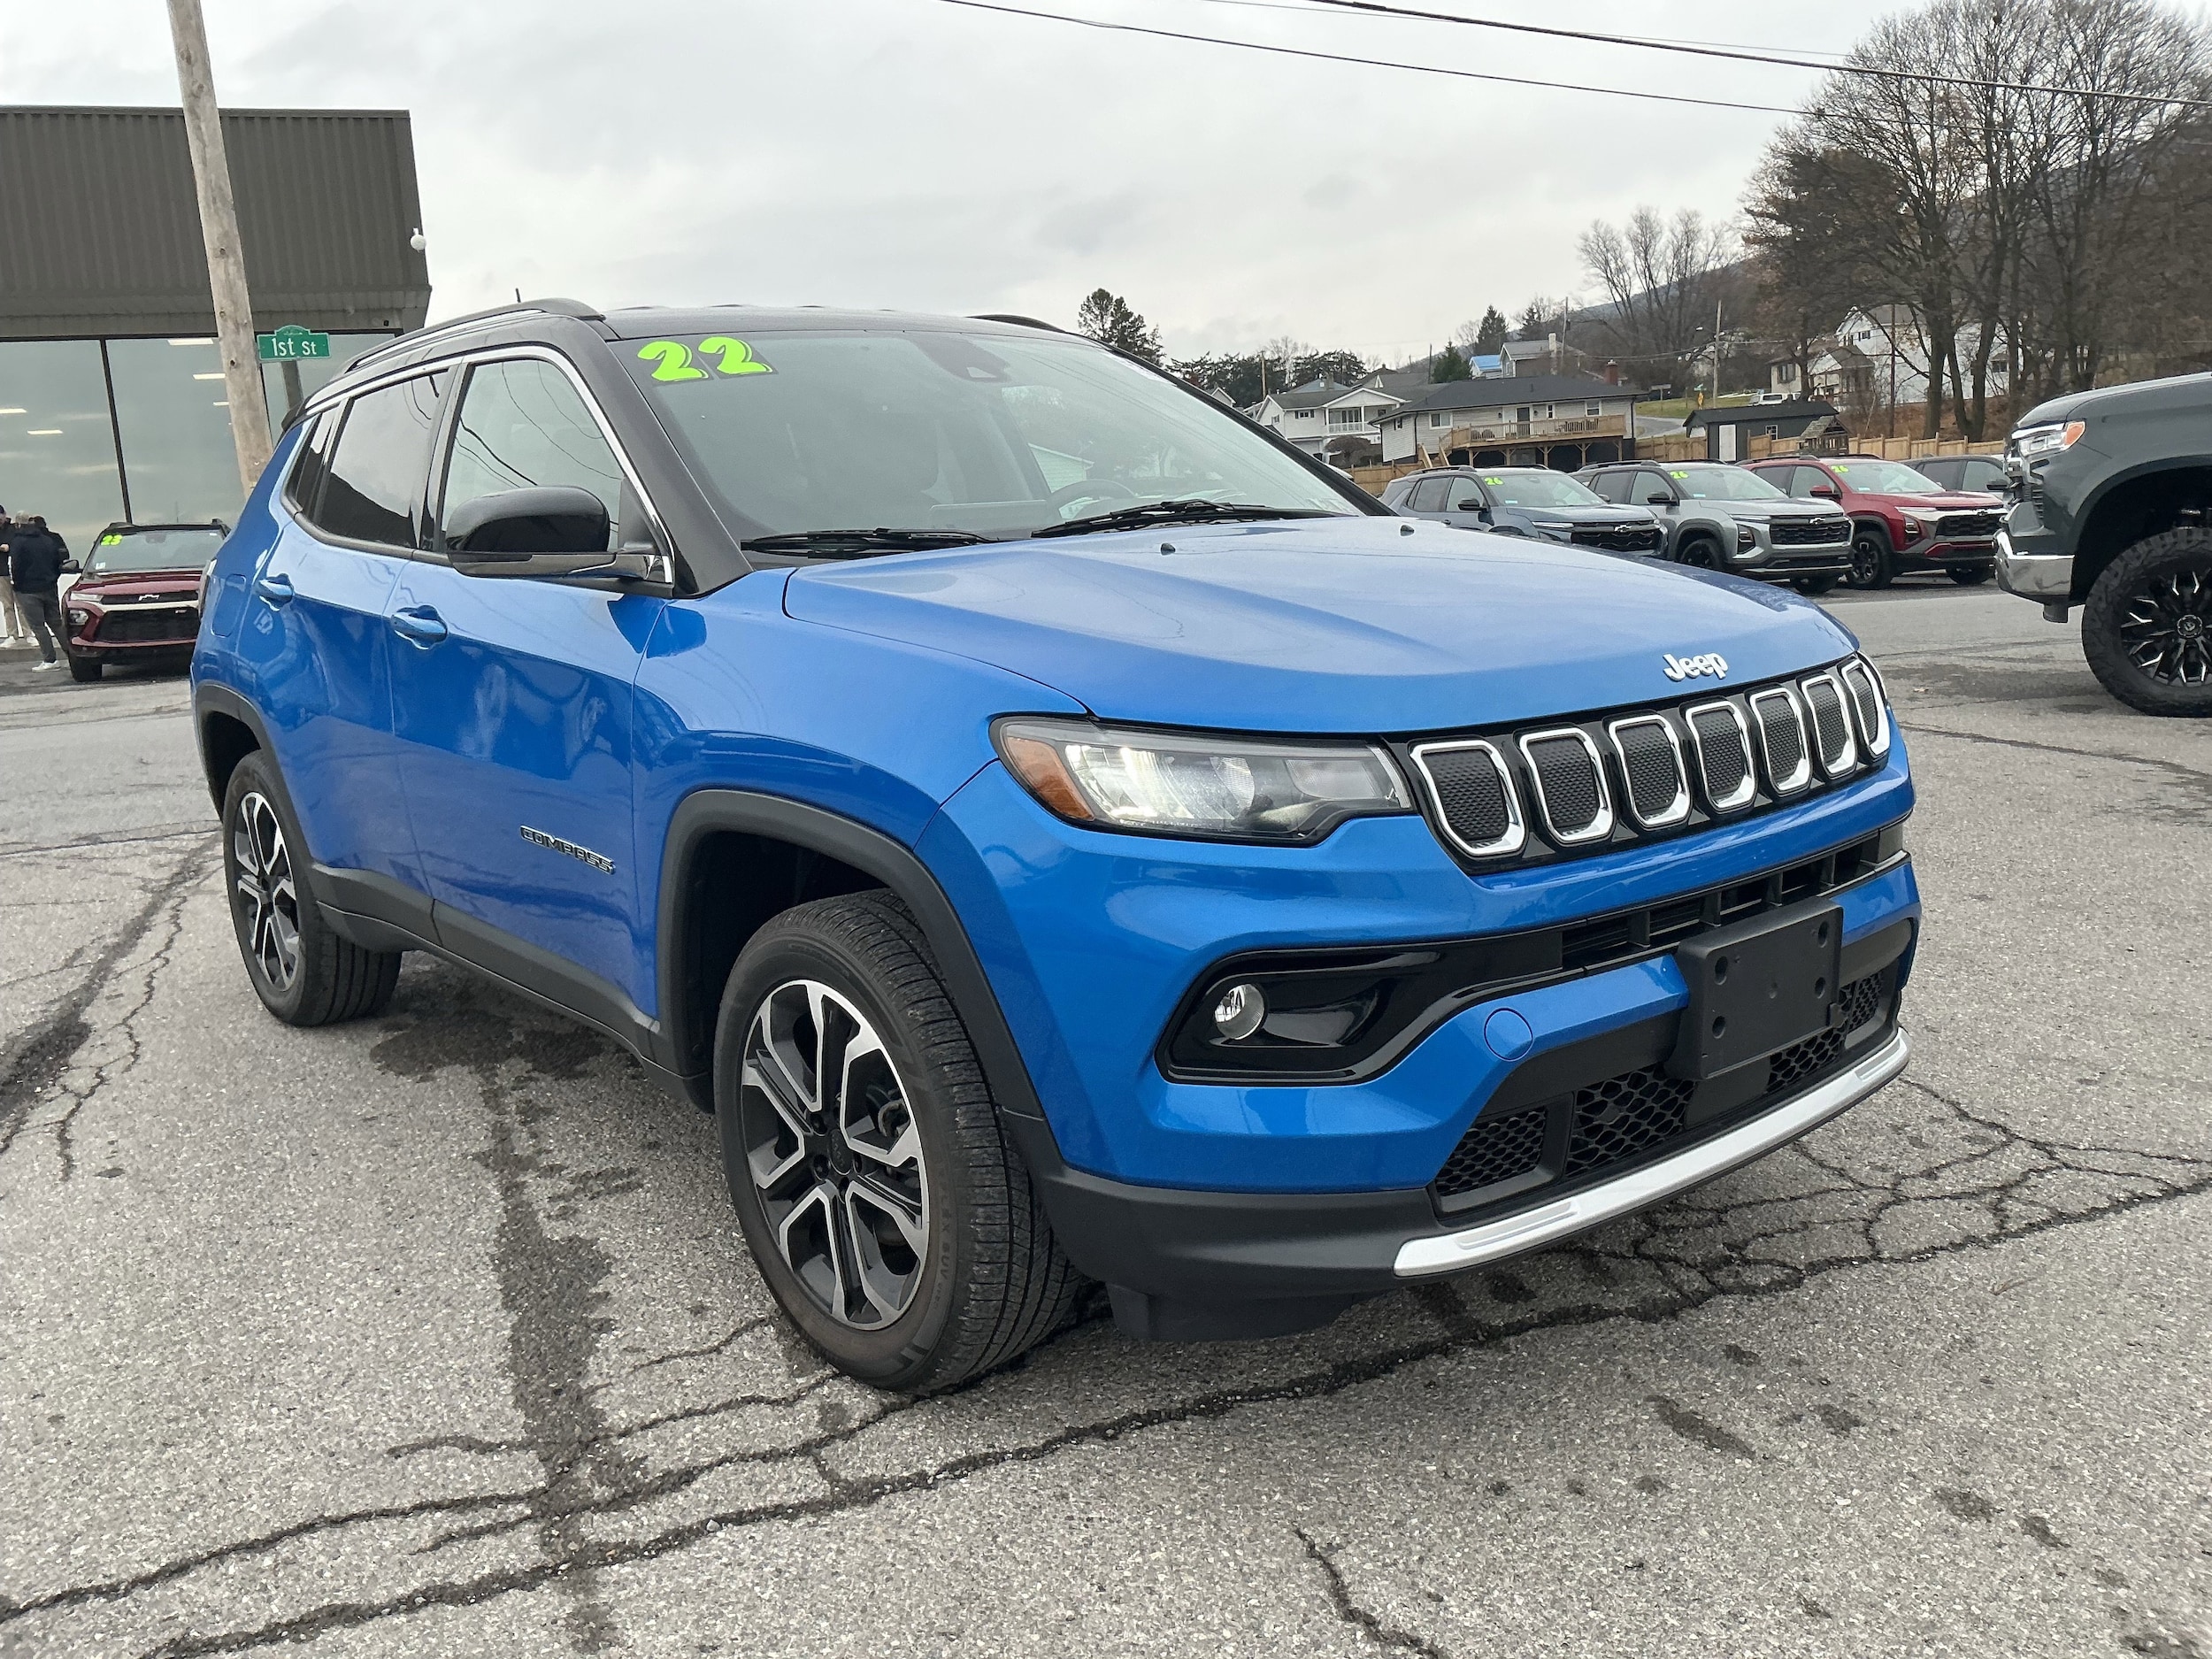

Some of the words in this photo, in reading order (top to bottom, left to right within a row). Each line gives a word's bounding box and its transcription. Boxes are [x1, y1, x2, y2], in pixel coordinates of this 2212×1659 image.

[272, 337, 296, 356] 1st
[301, 341, 317, 355] St
[637, 336, 772, 381] 22
[1663, 652, 1729, 682] Jeep
[519, 825, 617, 875] COMPASS
